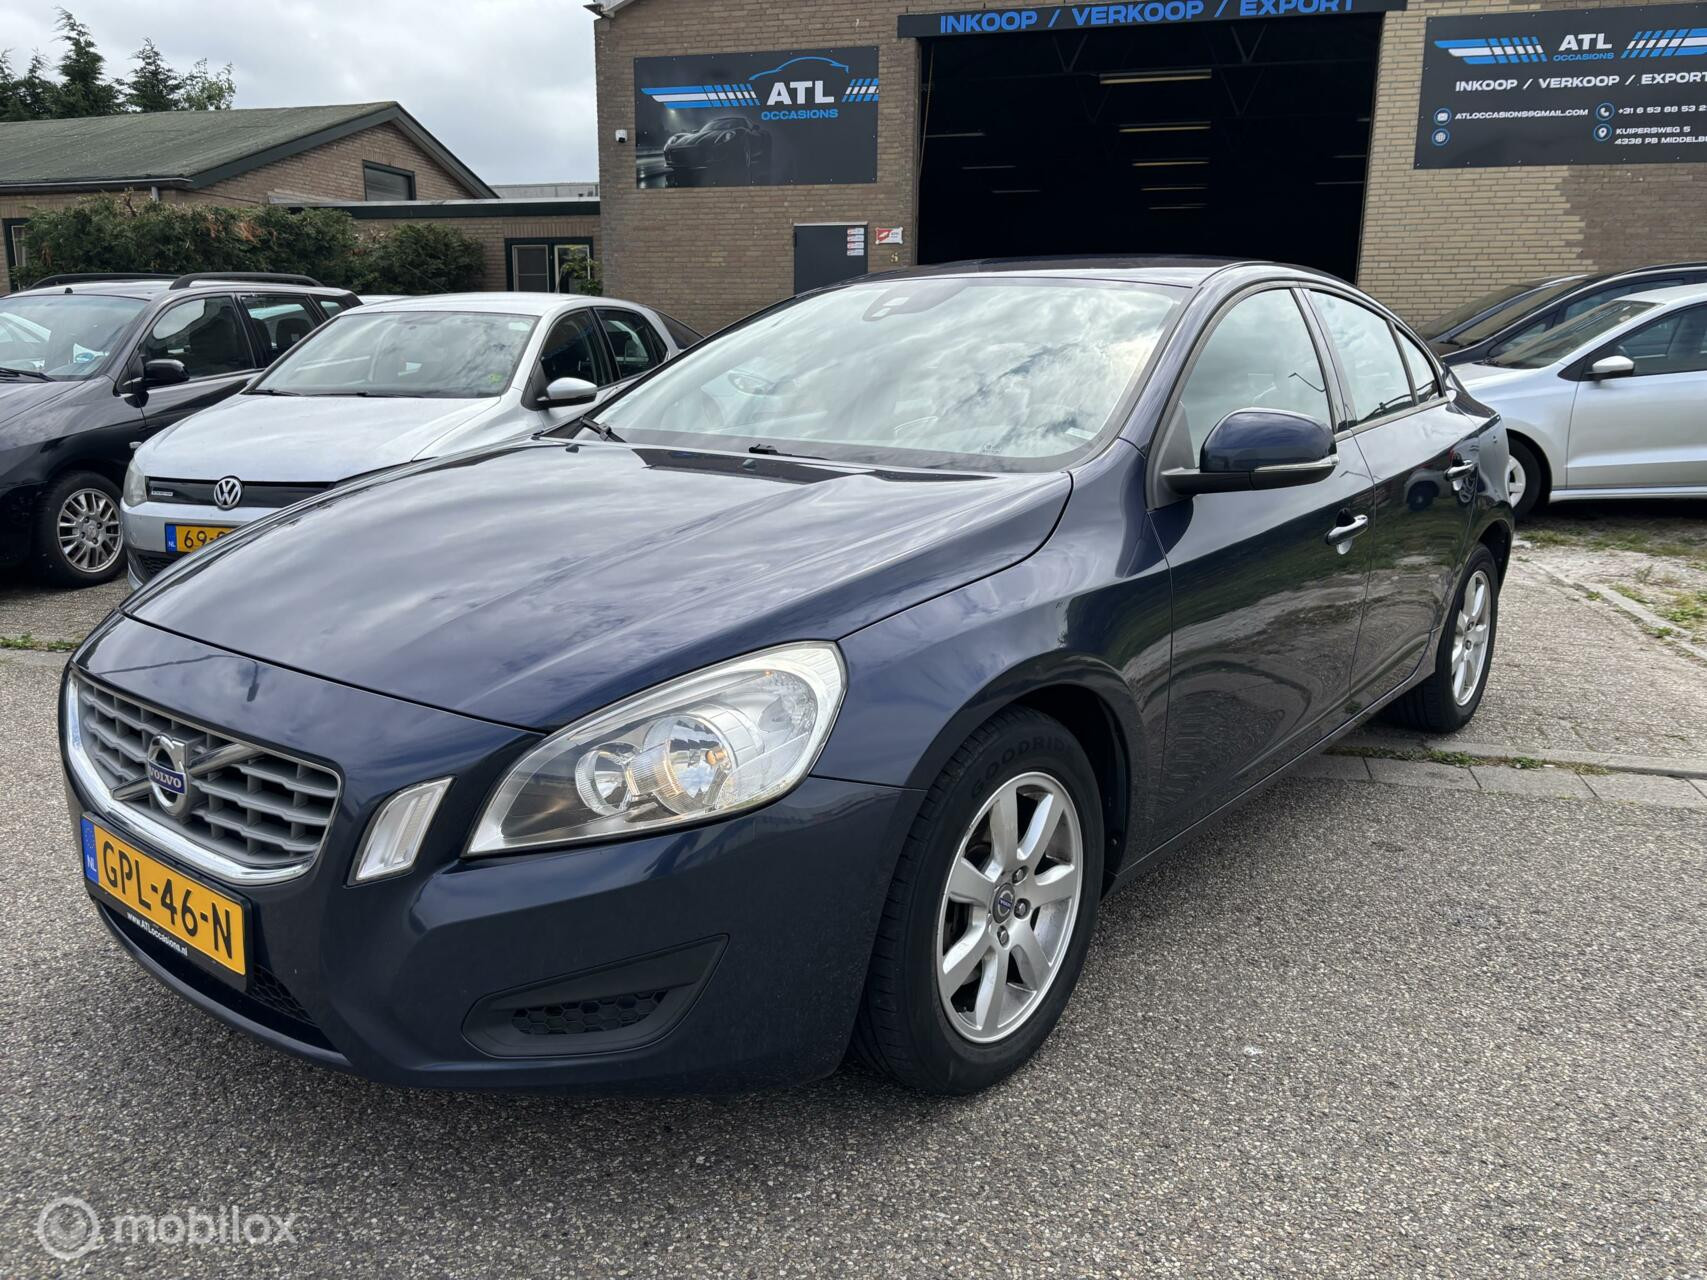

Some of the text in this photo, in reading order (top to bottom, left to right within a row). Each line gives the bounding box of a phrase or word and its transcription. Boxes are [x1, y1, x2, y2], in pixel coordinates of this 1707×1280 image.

[939, 10, 1037, 33] INKOOP
[1071, 1, 1203, 26] VERKOOP
[1239, 0, 1354, 16] EXPORT
[1558, 33, 1612, 51] ATL
[1552, 52, 1614, 62] OCCASIONS
[1455, 79, 1517, 91] INKOOP
[1538, 75, 1620, 89] VERKOOP
[766, 80, 834, 105] ATL
[761, 108, 839, 121] OCCASIONS
[1615, 126, 1680, 135] KUIPERSWEG
[149, 767, 182, 788] VOLVO
[86, 854, 97, 873] NL
[102, 840, 233, 960] GPL-46-N
